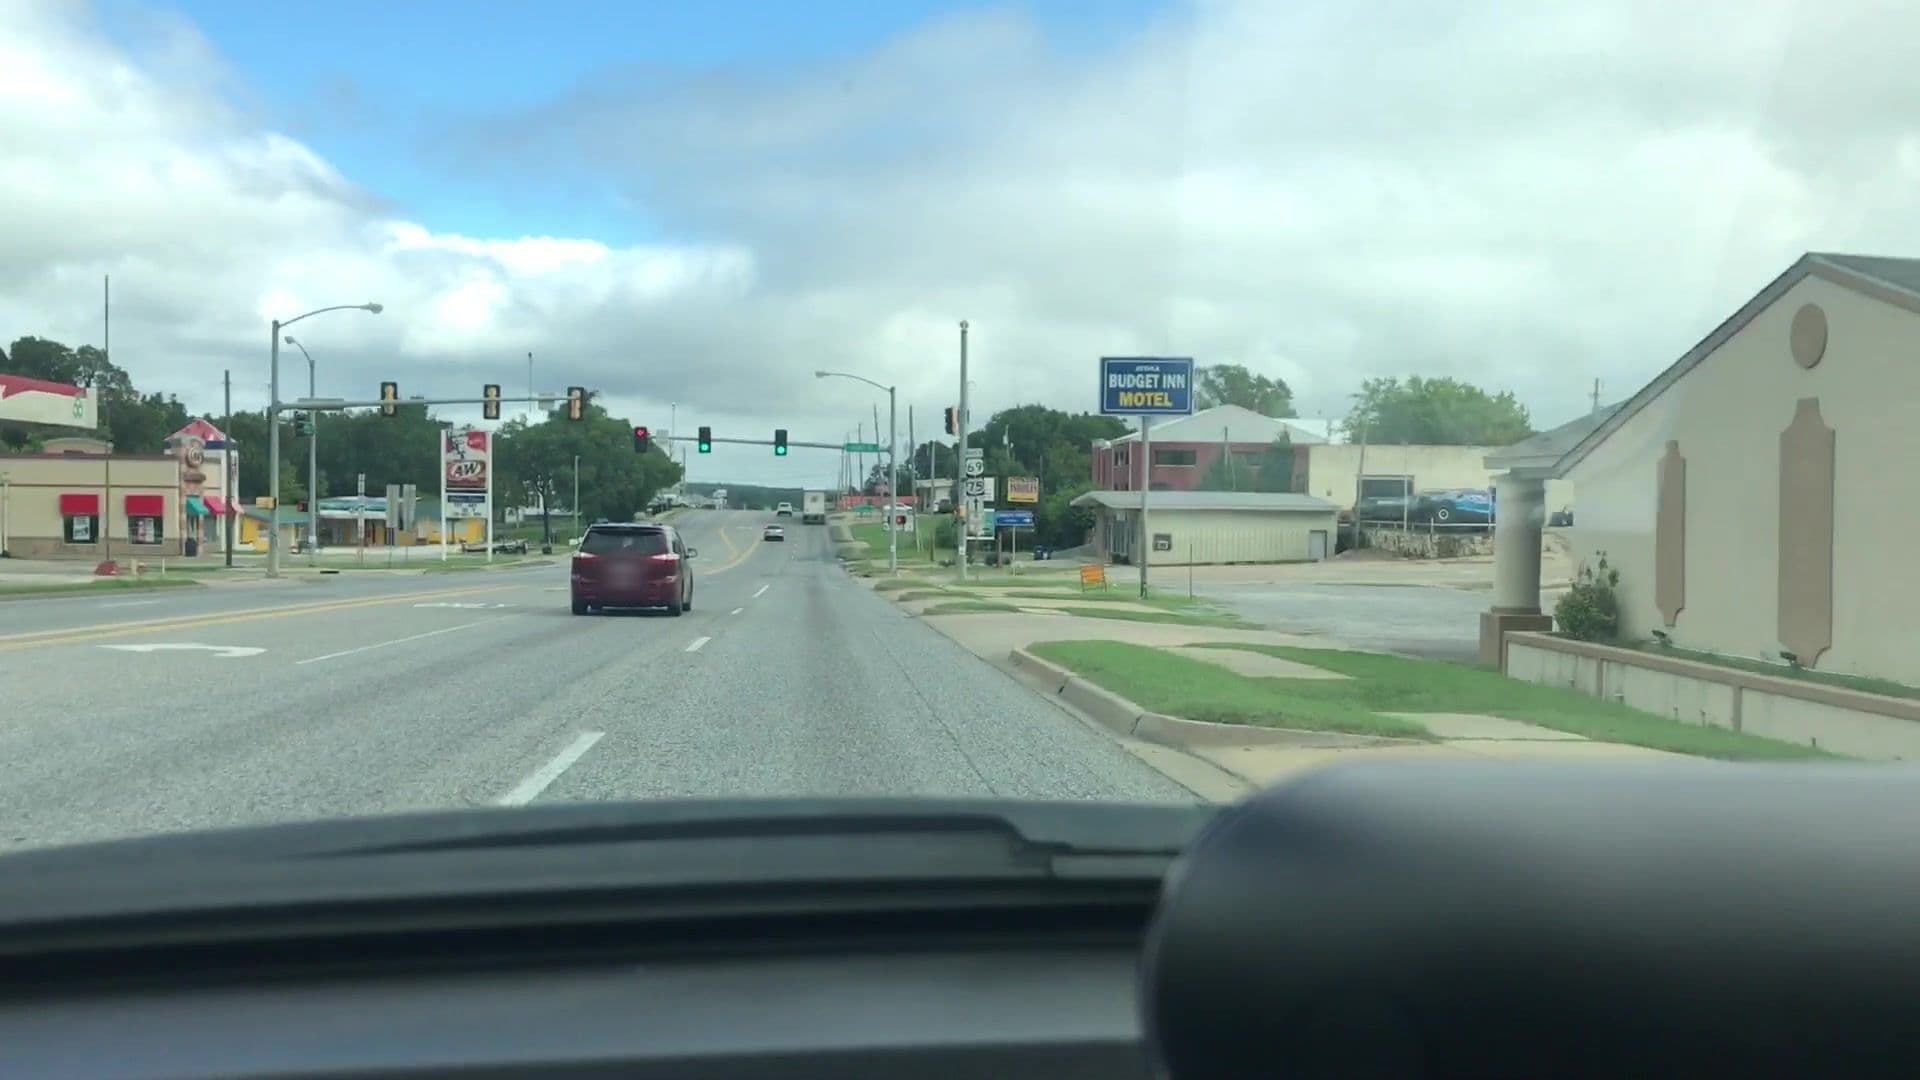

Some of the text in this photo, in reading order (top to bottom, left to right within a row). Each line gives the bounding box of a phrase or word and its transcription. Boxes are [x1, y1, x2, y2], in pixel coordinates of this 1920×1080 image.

[1109, 373, 1185, 389] BUDGET INN
[1119, 392, 1172, 407] MOTEL
[967, 461, 982, 473] 69
[966, 480, 984, 493] 75
